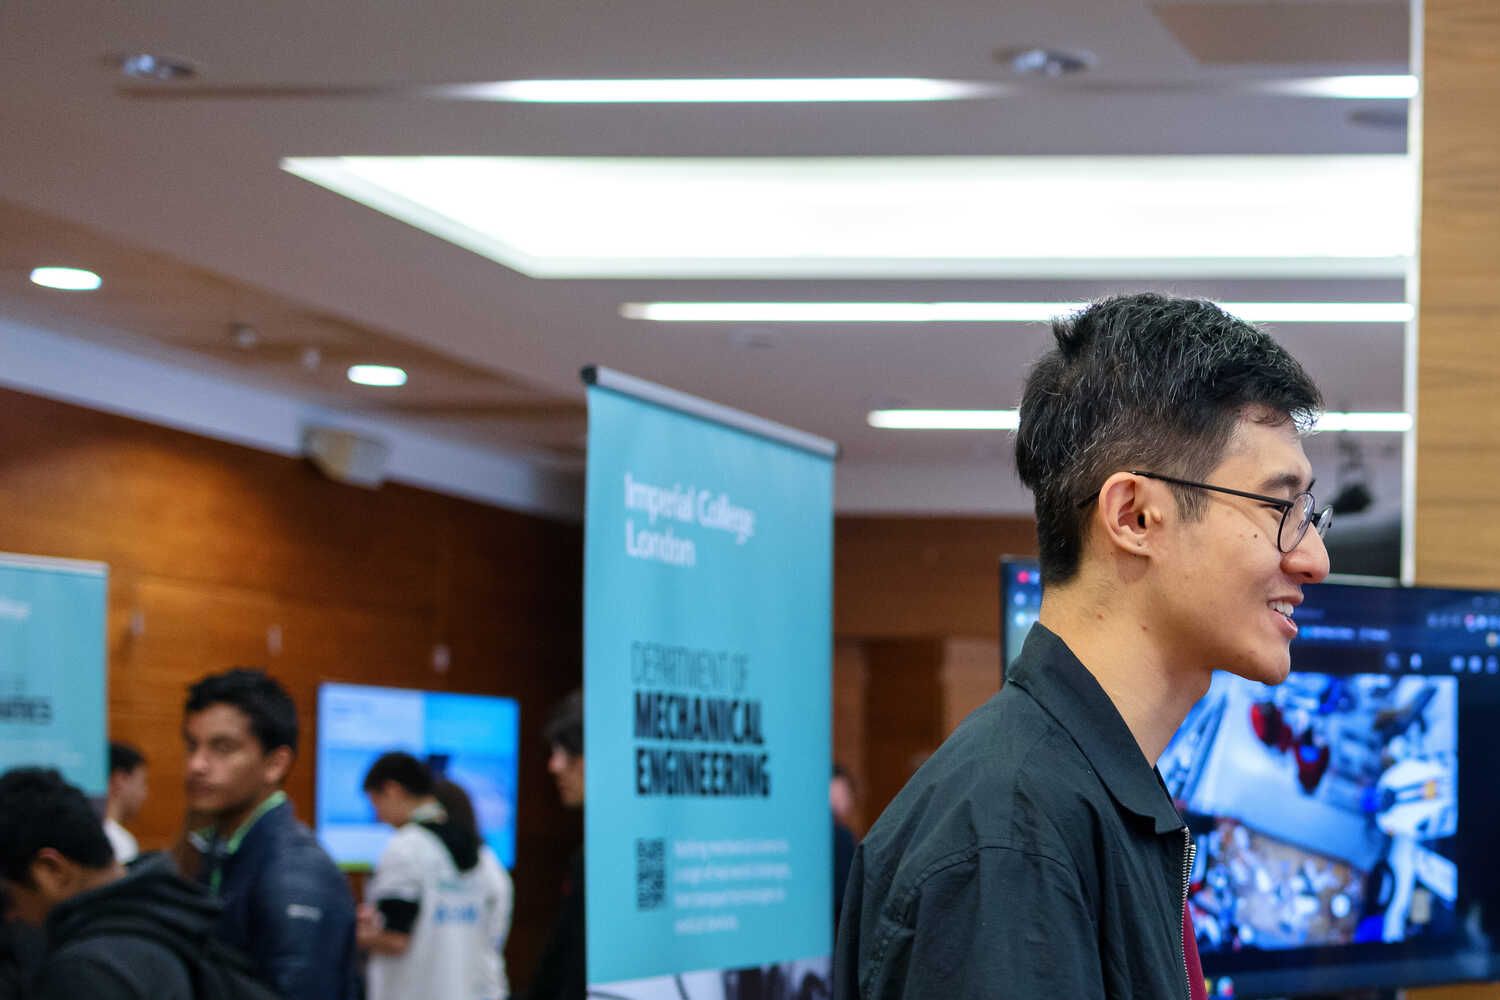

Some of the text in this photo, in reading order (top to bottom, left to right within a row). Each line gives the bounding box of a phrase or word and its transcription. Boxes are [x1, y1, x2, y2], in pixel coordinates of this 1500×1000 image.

[624, 472, 757, 545] Imperial College
[626, 519, 696, 567] London
[633, 689, 764, 745] MECHANICAL
[635, 747, 771, 798] ENGINEERING
